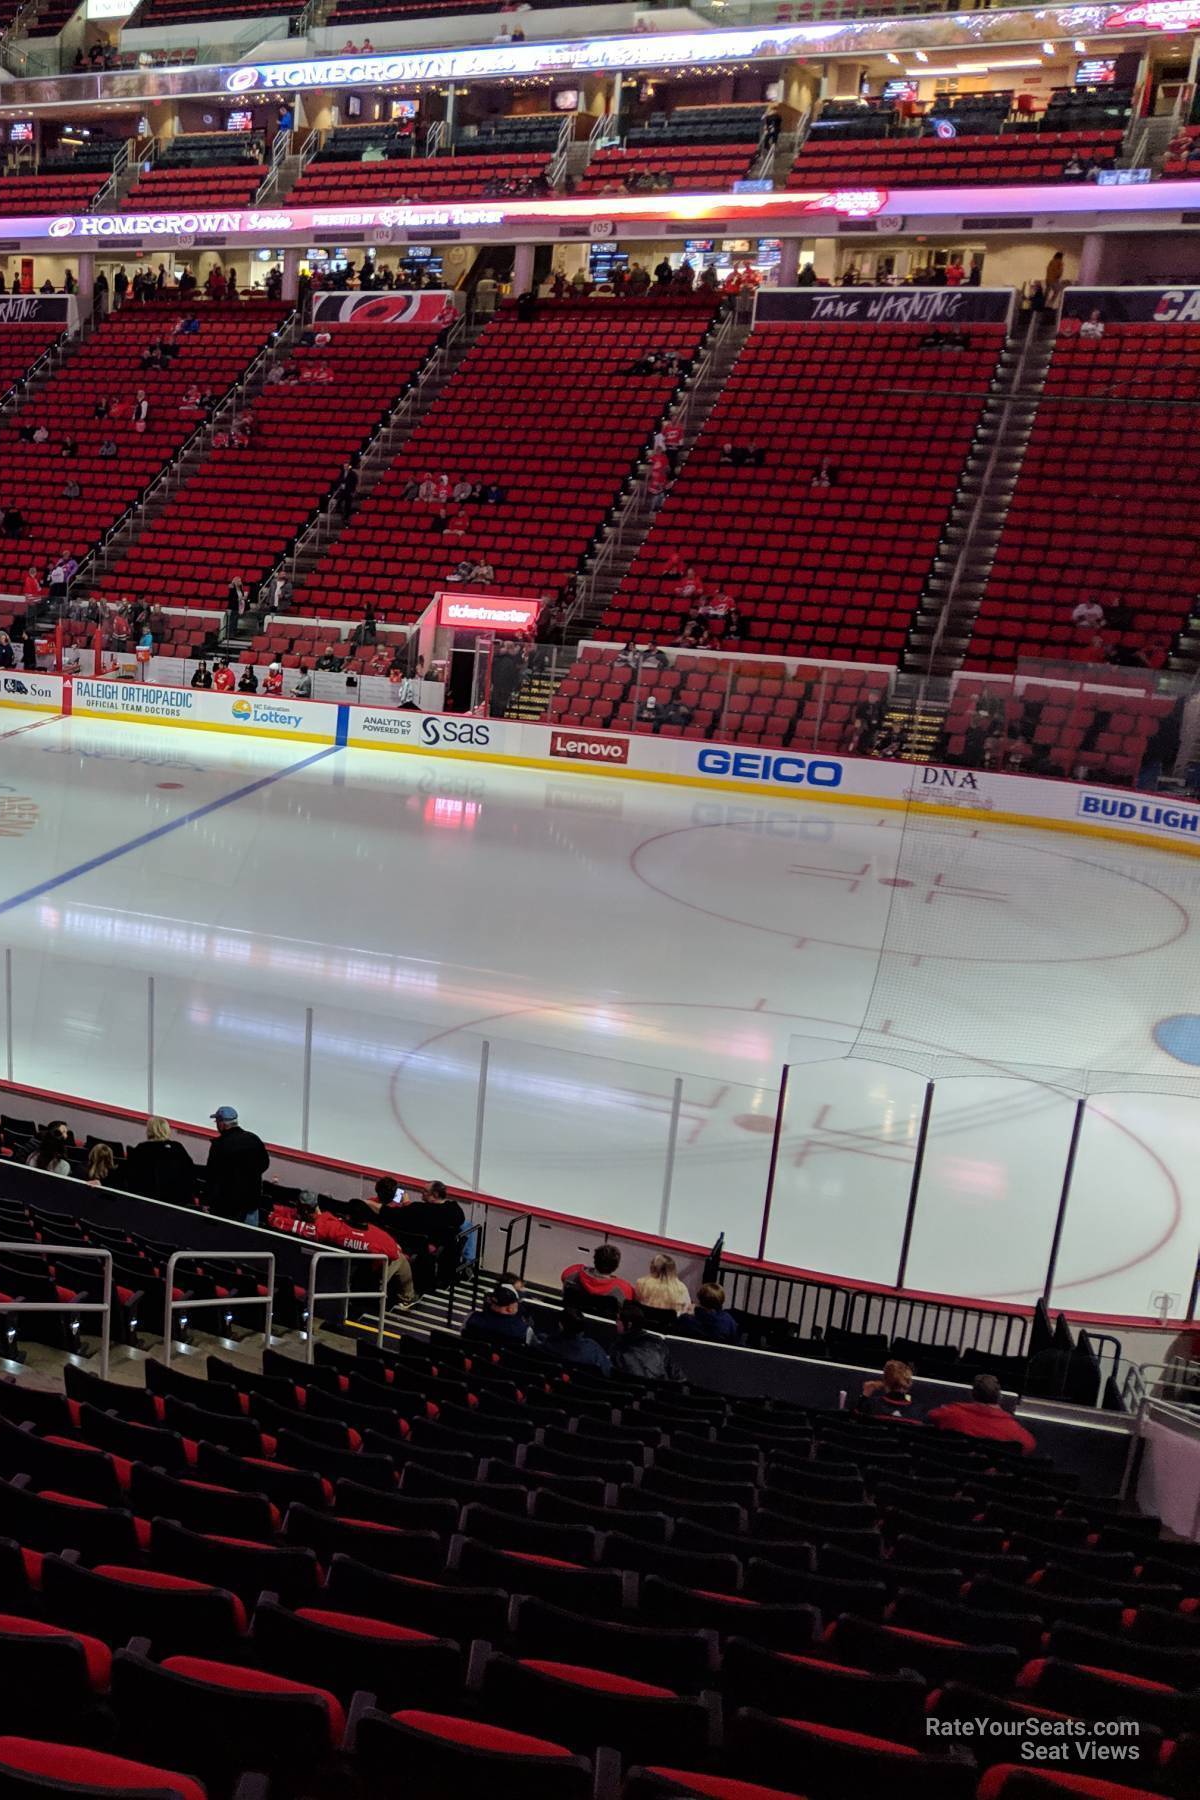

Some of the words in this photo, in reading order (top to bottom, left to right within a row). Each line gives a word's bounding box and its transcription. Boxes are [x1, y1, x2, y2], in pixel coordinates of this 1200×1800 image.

[81, 213, 243, 236] HOMEGROWN
[398, 208, 448, 226] Harris
[451, 207, 506, 224] Teeter
[593, 223, 609, 233] 105
[376, 229, 390, 239] 104
[811, 295, 860, 320] TAKE
[867, 291, 966, 323] WARNING
[1153, 290, 1200, 321] CA
[448, 604, 531, 623] ticketmaster
[30, 682, 52, 698] Son
[76, 681, 119, 701] RALEIGH
[121, 685, 193, 709] ORTHOPAEDIC
[86, 699, 119, 711] OFFICIAL
[121, 703, 144, 713] TEAM
[145, 705, 181, 717] DOCTORS
[253, 709, 303, 728] Lottery
[363, 716, 412, 728] ANALYTICS
[362, 724, 399, 735] POWERED
[400, 727, 412, 736] BY
[442, 721, 490, 746] sas
[556, 736, 623, 757] Lenovo
[698, 748, 843, 788] GEICO
[922, 767, 978, 789] DNA
[1082, 796, 1137, 820] BUD
[1140, 805, 1199, 832] LIGH
[343, 1238, 370, 1251] FAULK
